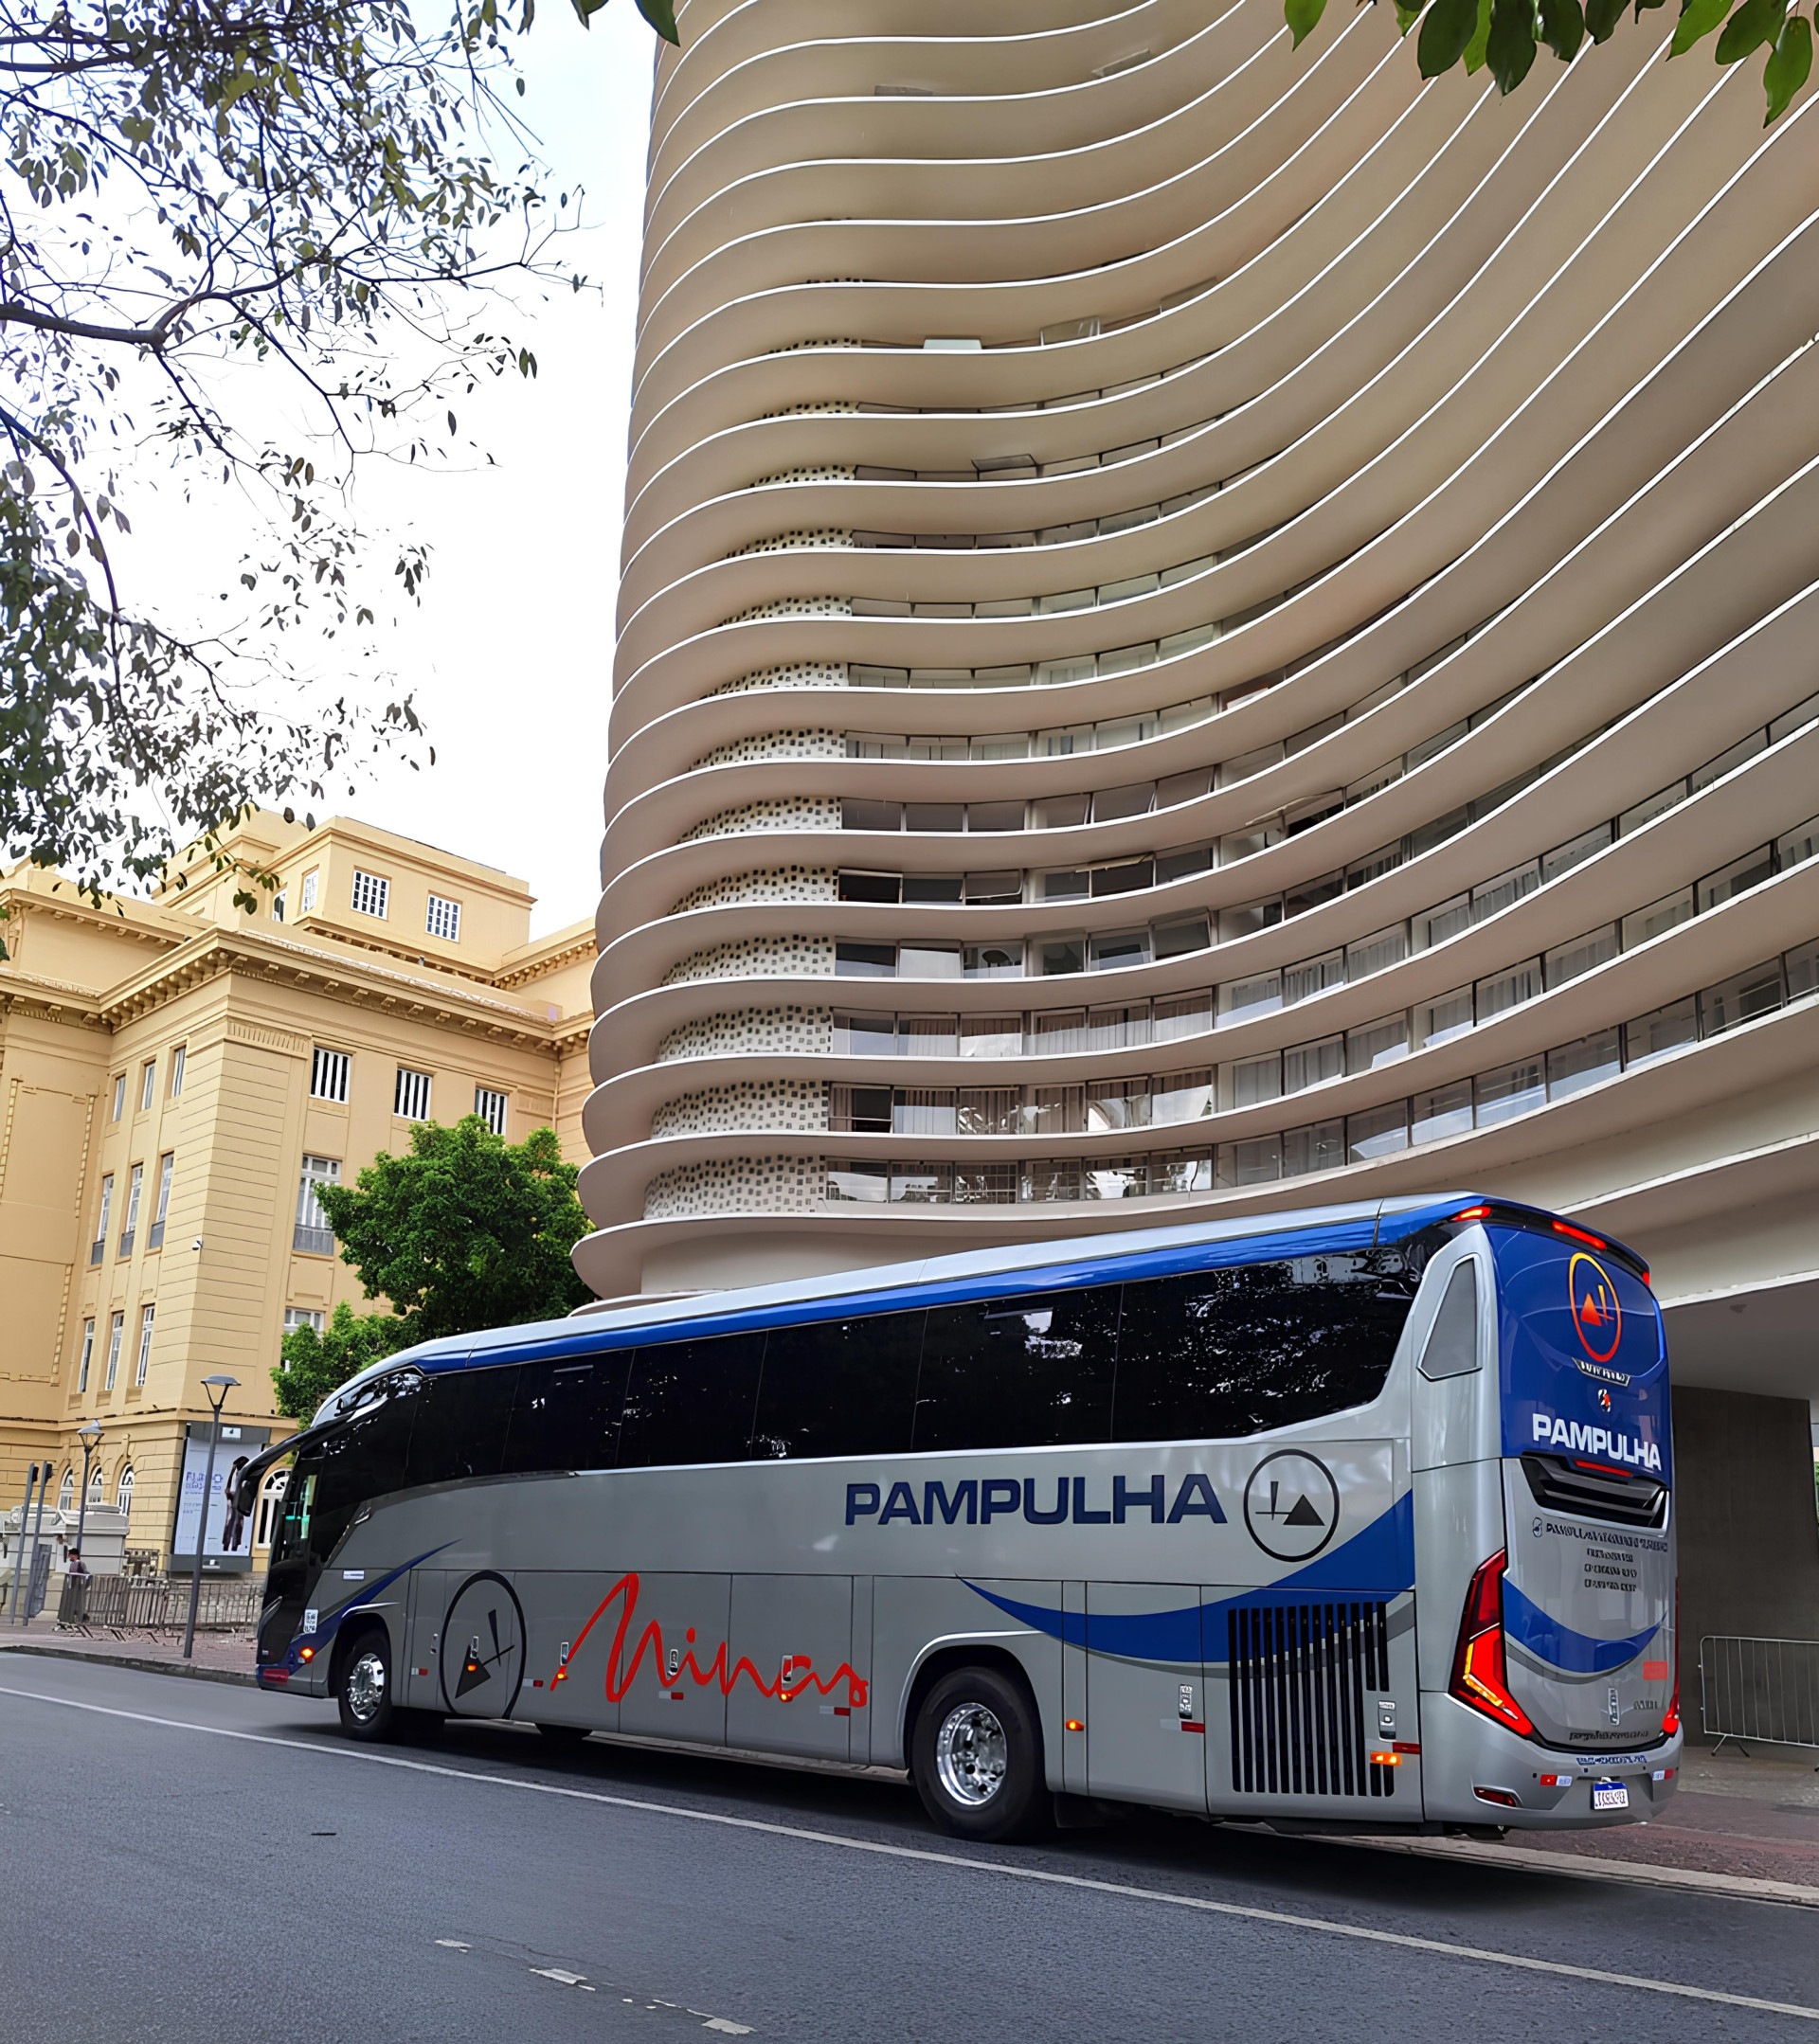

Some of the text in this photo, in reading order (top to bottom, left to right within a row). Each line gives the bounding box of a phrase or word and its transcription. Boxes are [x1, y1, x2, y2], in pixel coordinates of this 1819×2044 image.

[1532, 1412, 1662, 1471] PAMPULHA
[844, 1473, 1228, 1526] PAMPULHA
[549, 1572, 869, 1708] Minas
